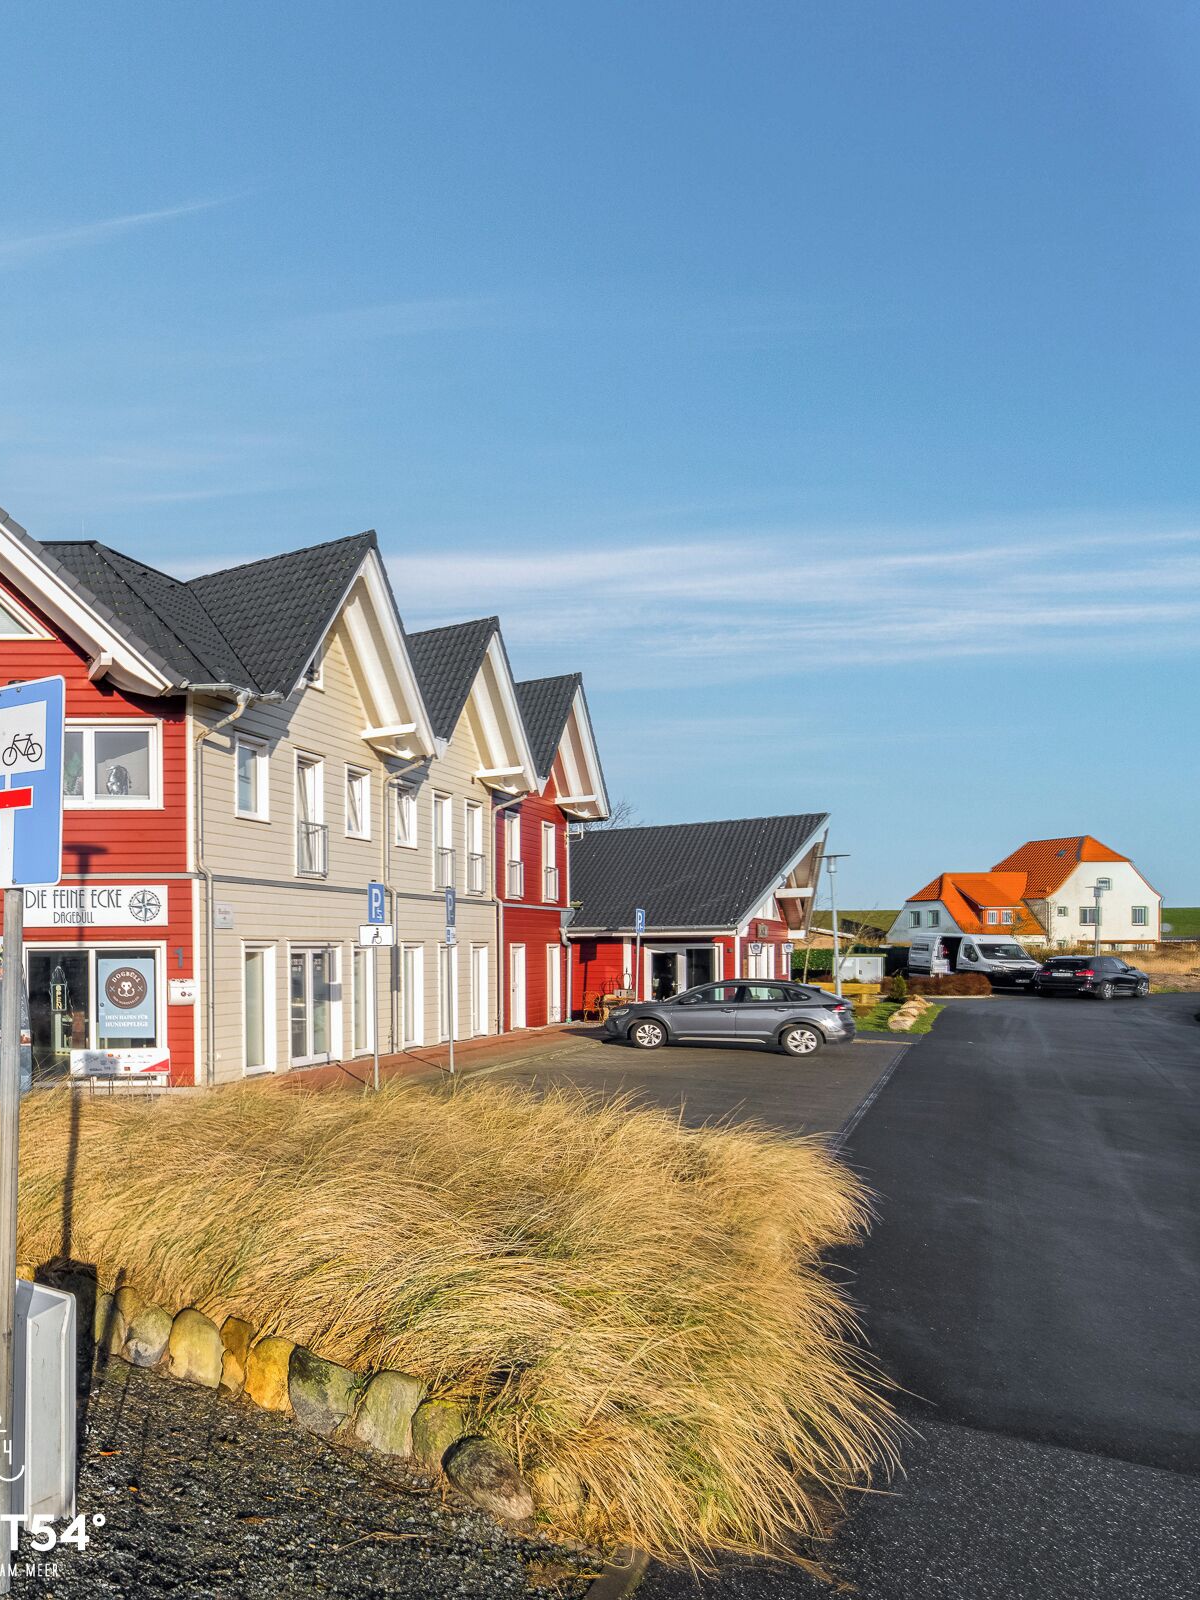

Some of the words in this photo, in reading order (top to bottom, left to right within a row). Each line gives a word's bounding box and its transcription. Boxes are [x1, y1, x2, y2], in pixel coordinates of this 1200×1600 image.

[25, 889, 47, 909] DIE
[53, 889, 85, 909] FEINE
[91, 889, 122, 908] ECKE
[372, 888, 381, 918] P
[53, 910, 95, 924] DAGEBÜLL
[174, 946, 184, 969] 1
